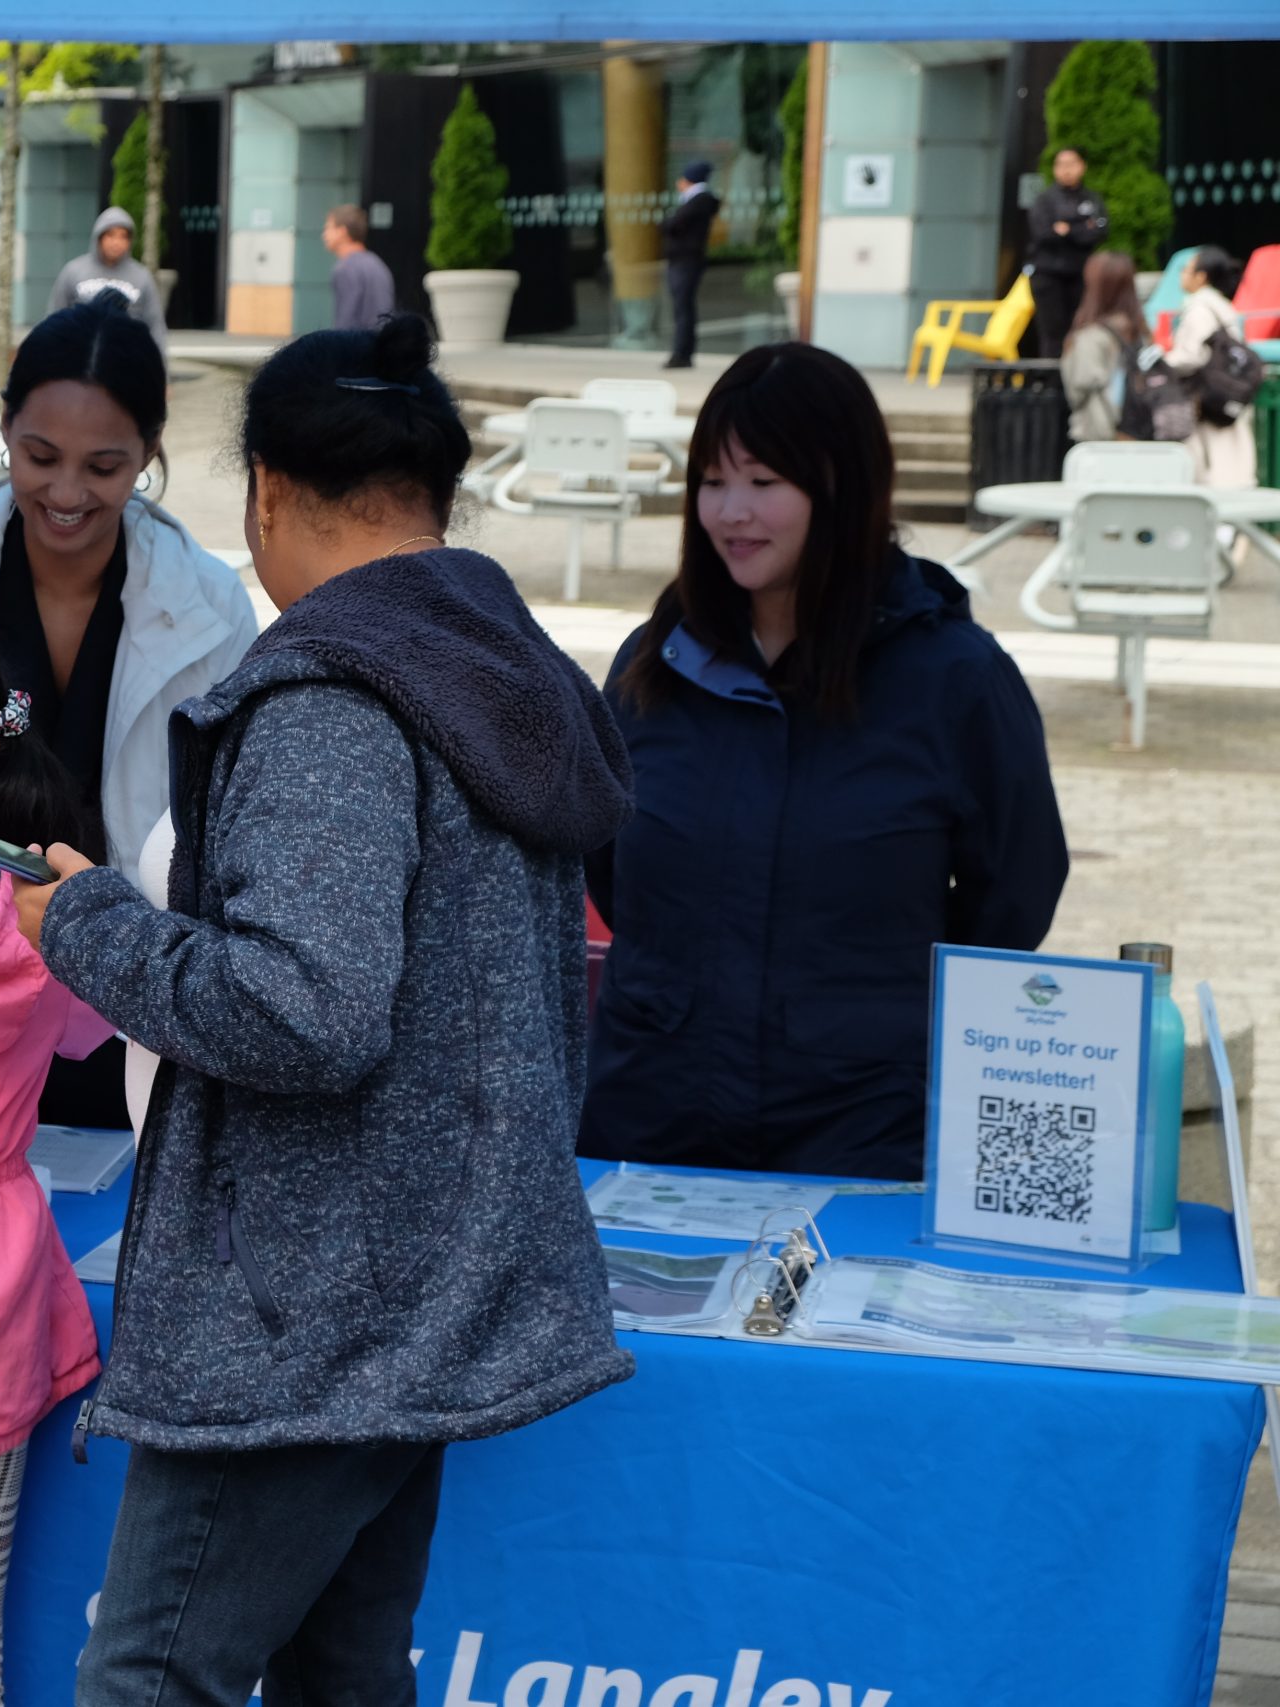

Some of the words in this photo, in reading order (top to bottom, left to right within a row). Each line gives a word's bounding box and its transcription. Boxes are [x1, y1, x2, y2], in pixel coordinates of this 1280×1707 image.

[964, 1028, 1009, 1052] Sign
[1016, 1038, 1042, 1056] up
[1048, 1037, 1077, 1056] for
[1082, 1045, 1118, 1061] our
[982, 1066, 1095, 1091] newsletter!
